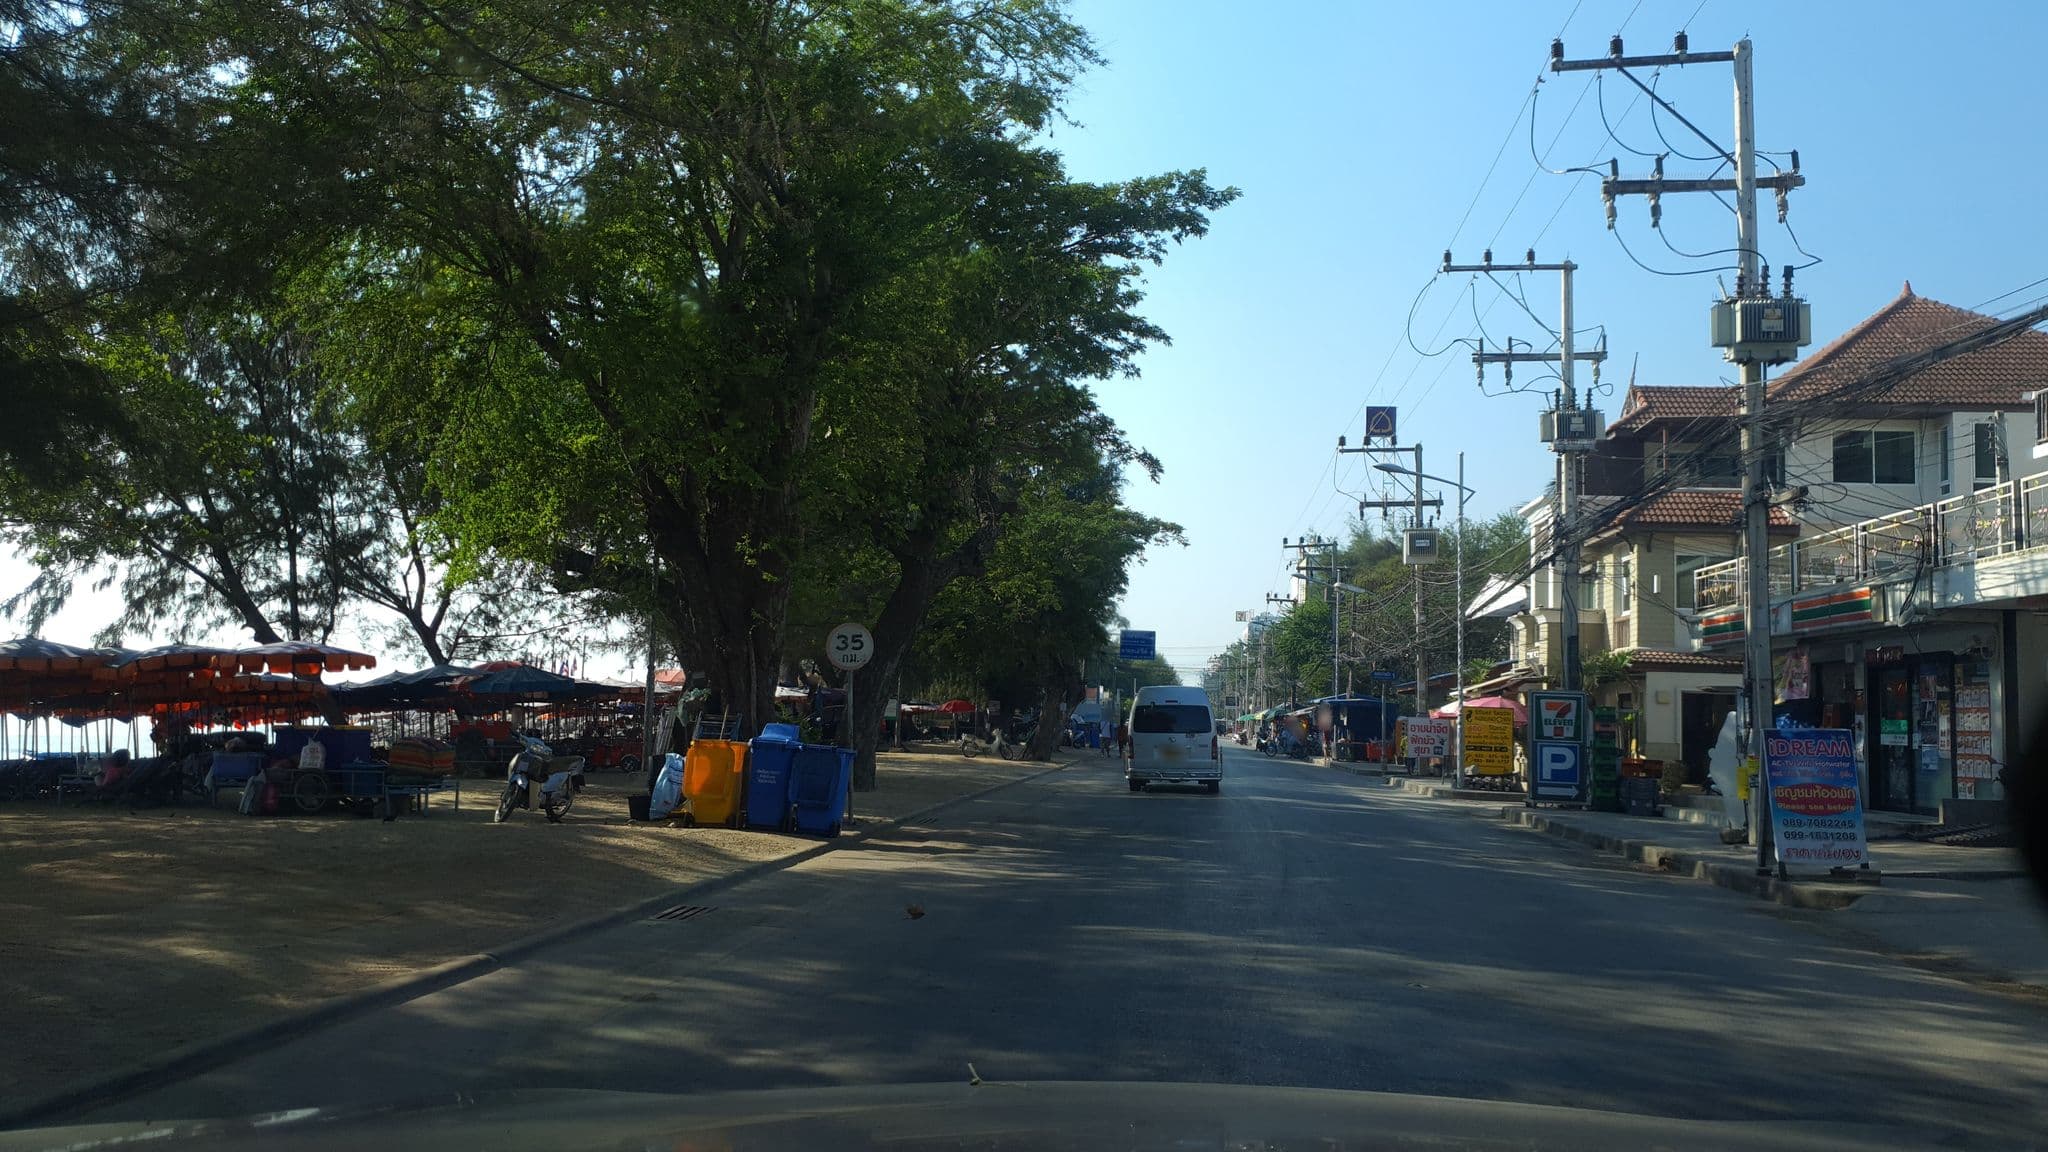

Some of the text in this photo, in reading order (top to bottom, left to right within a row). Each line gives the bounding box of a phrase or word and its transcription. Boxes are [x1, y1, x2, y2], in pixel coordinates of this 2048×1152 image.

[836, 634, 864, 651] 35
[842, 654, 860, 663] กม.
[1545, 701, 1572, 718] 7
[1410, 720, 1448, 734] อาบน้ำจืด
[1768, 738, 1851, 758] iDREAM
[1542, 746, 1576, 780] P
